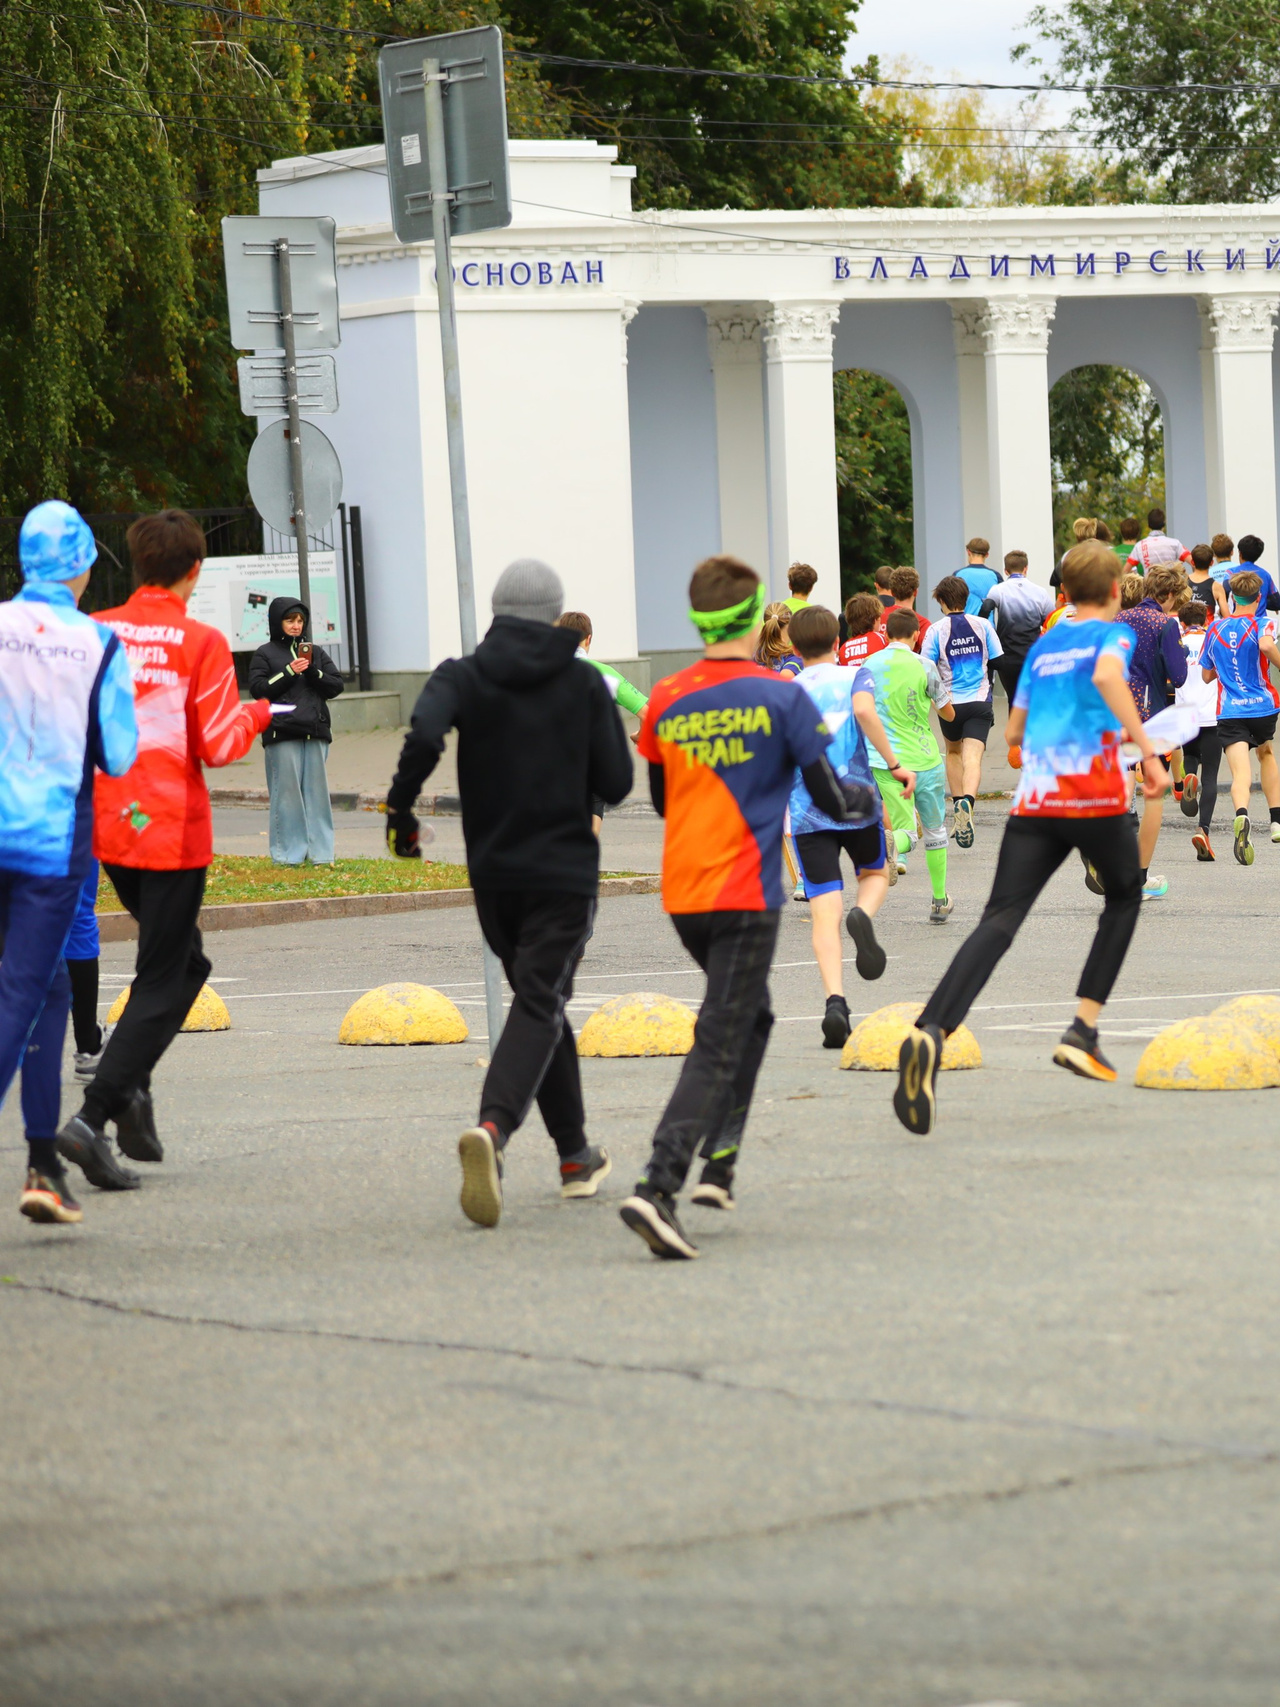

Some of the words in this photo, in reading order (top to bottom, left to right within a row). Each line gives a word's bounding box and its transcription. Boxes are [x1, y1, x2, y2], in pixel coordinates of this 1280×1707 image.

[951, 636, 975, 646] CRAFT
[844, 643, 868, 659] STAR
[949, 645, 980, 657] ORIENTA
[657, 705, 772, 743] UGRESHA
[678, 736, 755, 770] TRAIL
